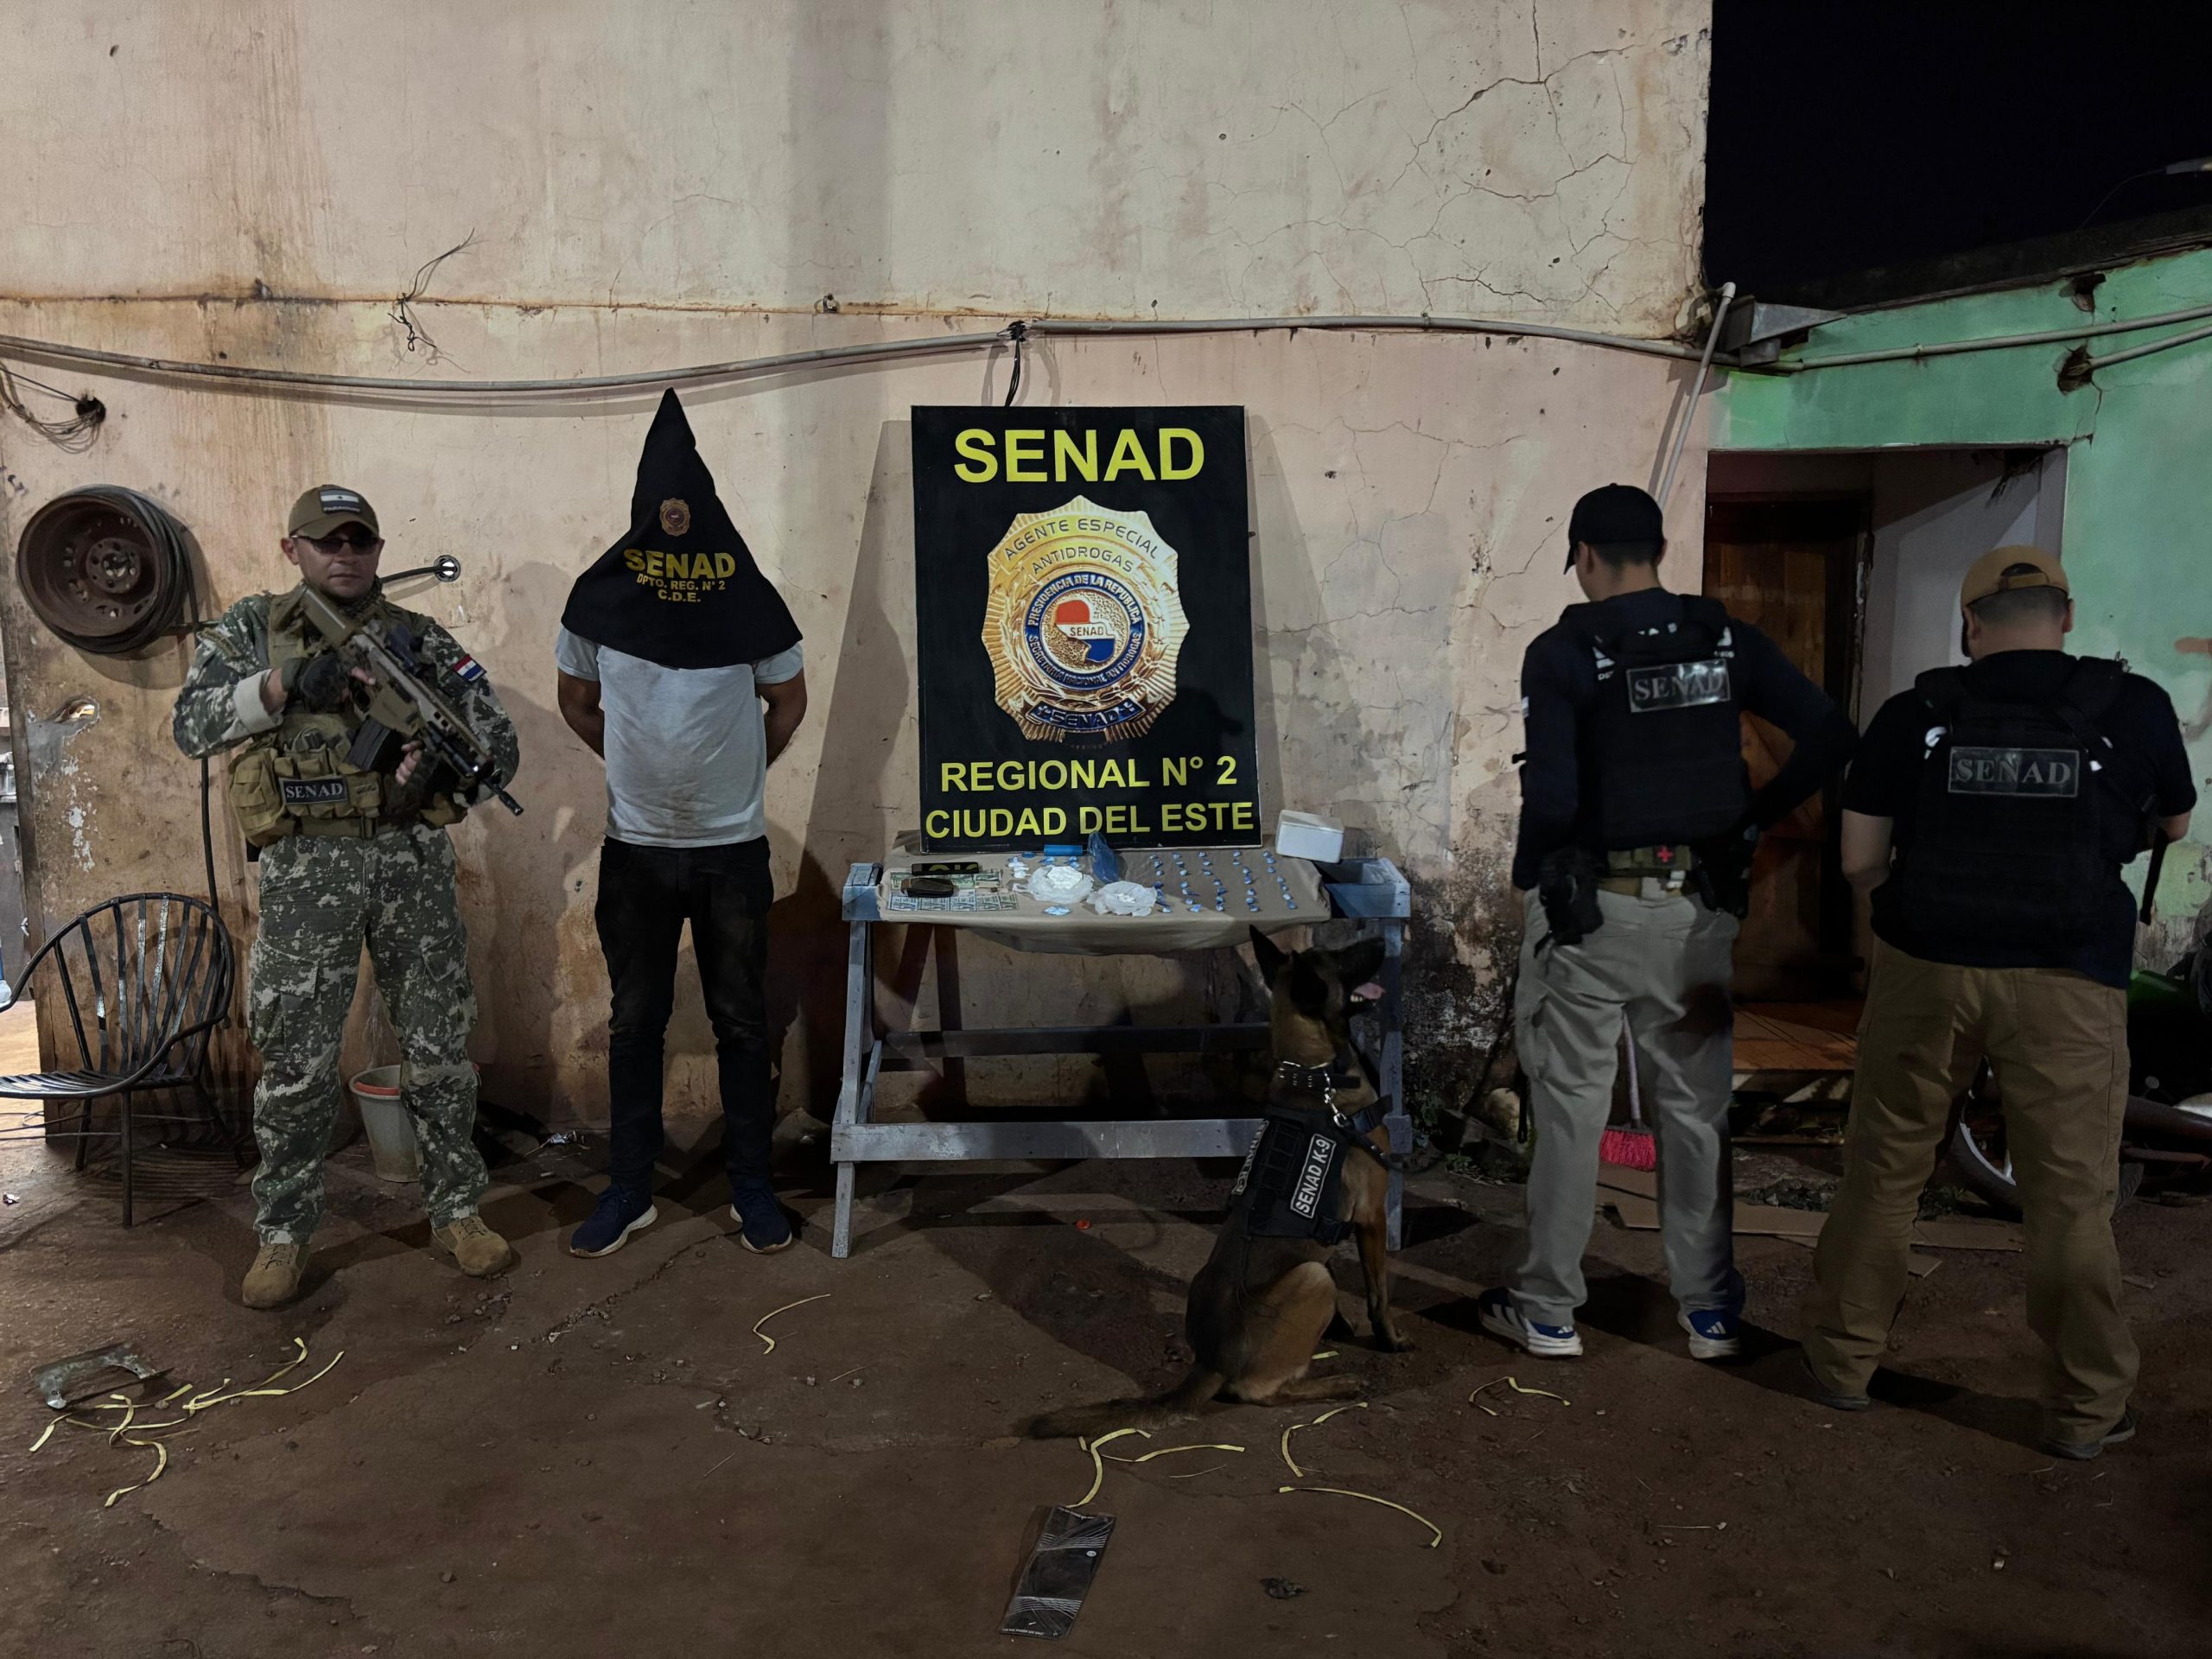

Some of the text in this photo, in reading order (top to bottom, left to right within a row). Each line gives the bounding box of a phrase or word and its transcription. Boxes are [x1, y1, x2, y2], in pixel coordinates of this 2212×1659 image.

[954, 428, 1205, 483] SENAD
[1005, 518, 1159, 561] AGENTE ESPECIAL
[623, 549, 736, 579] SENAD
[1031, 546, 1134, 575] ANTIDROGAS
[636, 573, 668, 588] DPTO.
[671, 581, 699, 591] REG.
[719, 581, 726, 590] 2
[658, 589, 702, 602] C.D.E.
[1027, 576, 1075, 626] PRESIDENCIA
[1074, 575, 1089, 585] DE
[1090, 575, 1105, 587] LA
[1070, 626, 1104, 637] SENAD
[1634, 671, 1724, 701] SENAD
[1050, 706, 1120, 726] SENAD
[941, 759, 1150, 792] REGIONAL
[1216, 755, 1237, 785] 2
[1955, 758, 2071, 785] SENAD
[285, 783, 344, 798] SENAD
[925, 801, 1254, 839] CIUDAD DEL ESTE
[1296, 1138, 1331, 1213] SENAD K-9
